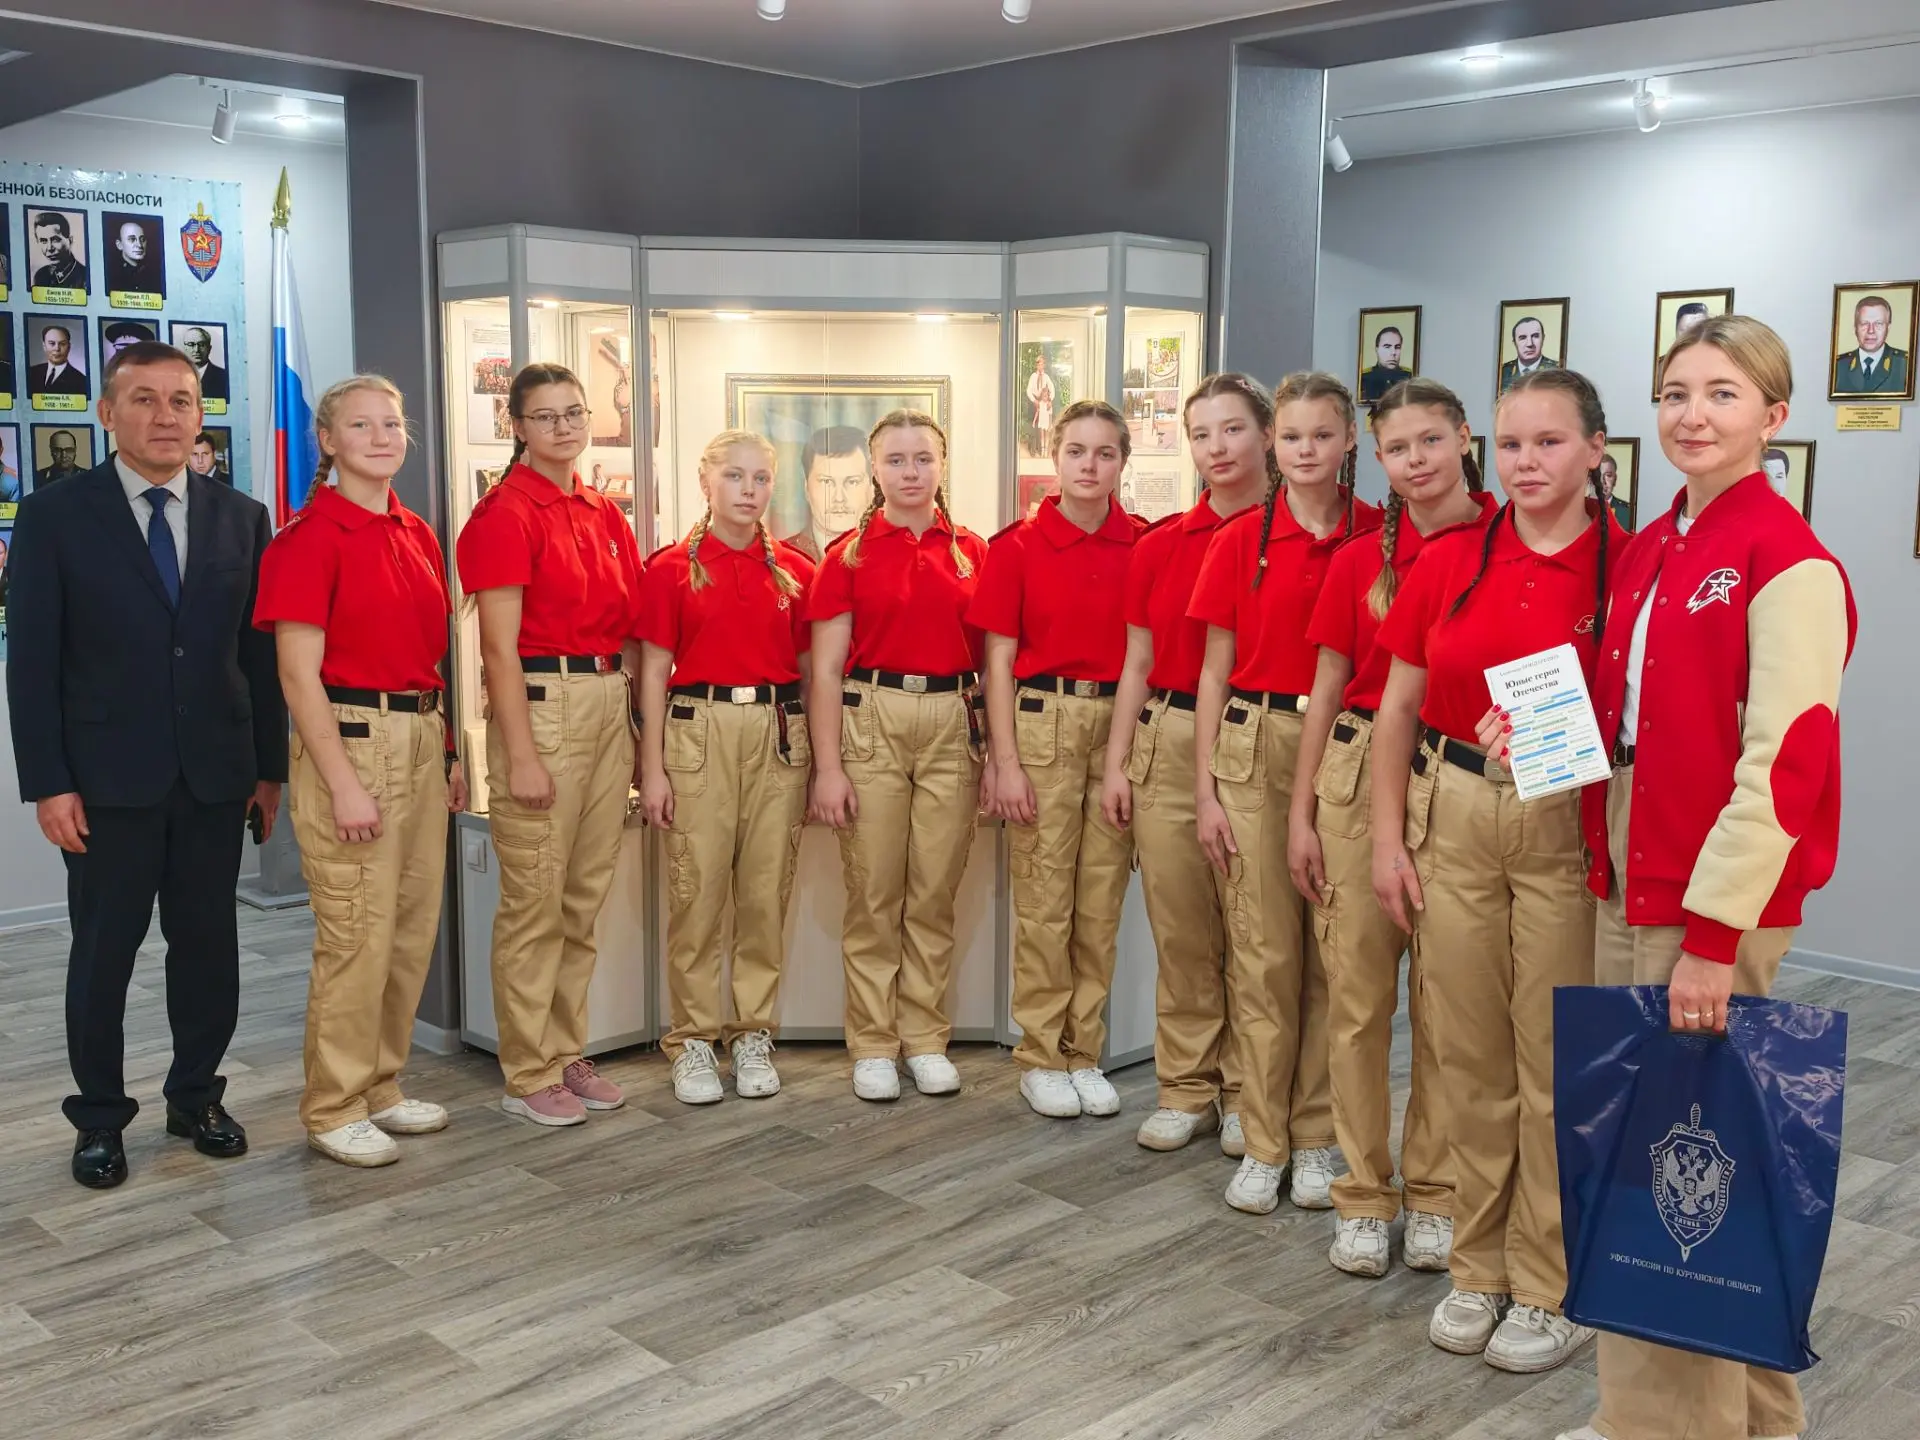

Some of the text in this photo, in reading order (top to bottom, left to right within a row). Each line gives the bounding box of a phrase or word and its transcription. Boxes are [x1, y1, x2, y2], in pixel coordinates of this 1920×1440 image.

[49, 186, 163, 207] БЕЗОПАСНОСТИ
[1505, 676, 1533, 689] Юные
[1512, 680, 1558, 698] Отечества
[1609, 1253, 1761, 1294] УФСБ РОССИИ ПО КУРГАНСКОЙ ОБЛАСТИ
